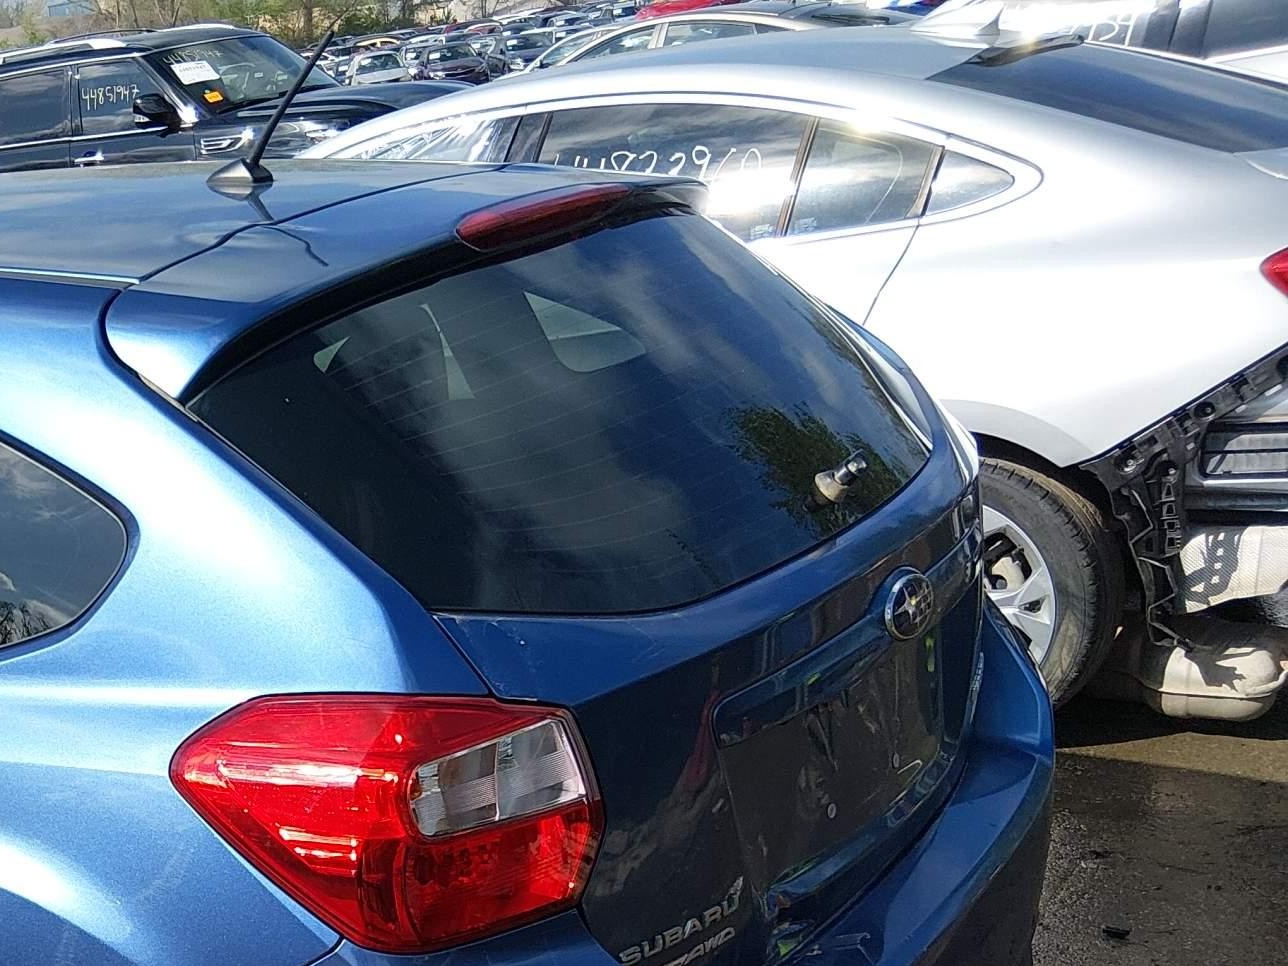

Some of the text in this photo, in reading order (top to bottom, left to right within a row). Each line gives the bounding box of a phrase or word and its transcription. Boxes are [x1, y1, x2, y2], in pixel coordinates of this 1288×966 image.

[81, 84, 141, 111] 44851947
[618, 875, 744, 966] SUBARU
[685, 926, 736, 965] AWD
